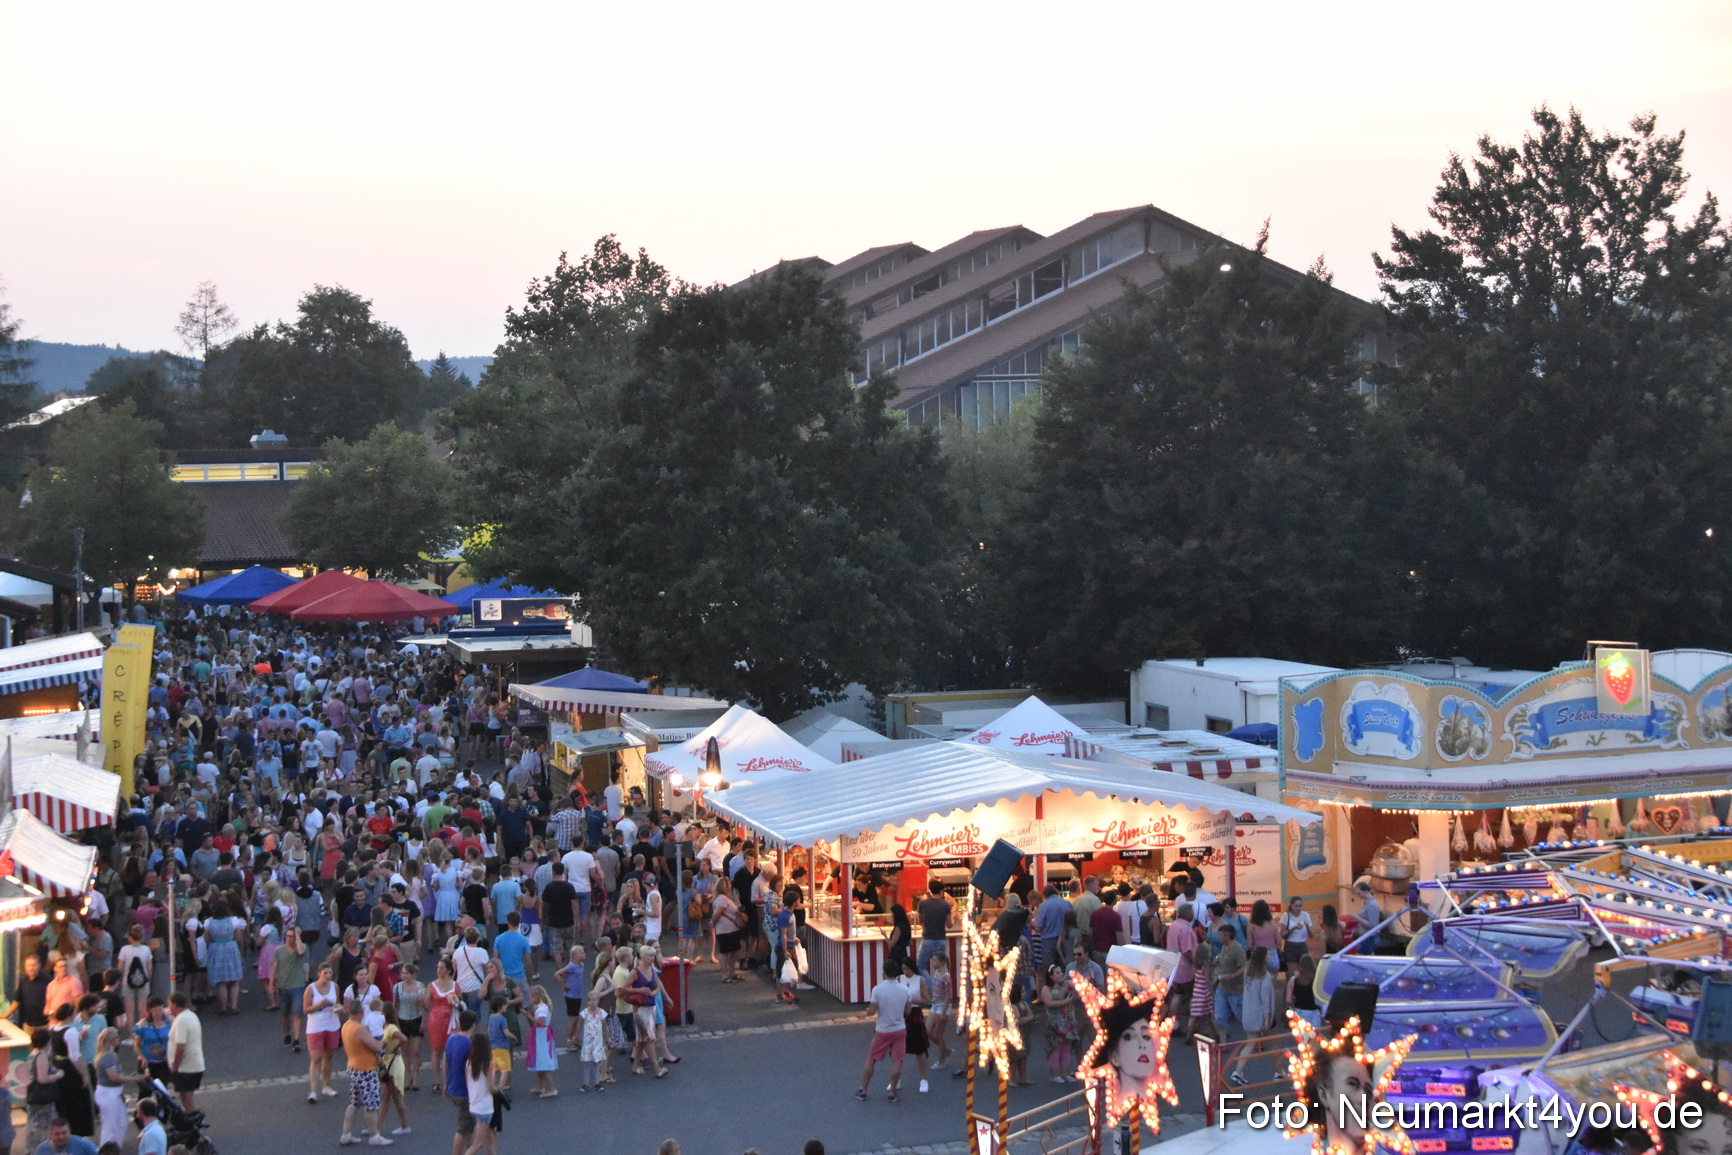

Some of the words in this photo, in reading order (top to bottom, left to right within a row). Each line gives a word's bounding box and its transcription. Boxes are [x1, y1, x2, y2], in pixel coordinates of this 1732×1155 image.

[657, 733, 685, 742] Matjes-
[737, 757, 803, 773] Lehmeier's
[1017, 822, 1032, 837] und
[1187, 819, 1212, 832] Genuss
[1213, 814, 1229, 827] und
[1092, 815, 1177, 850] Lehmeier's
[1145, 834, 1180, 845] IMBISS
[894, 823, 980, 859] Lehmeier's
[851, 848, 862, 858] 50
[863, 842, 889, 857] Jahren
[949, 843, 984, 855] IMBISS
[872, 861, 901, 870] Bratwurst
[929, 859, 962, 867] Currywurst
